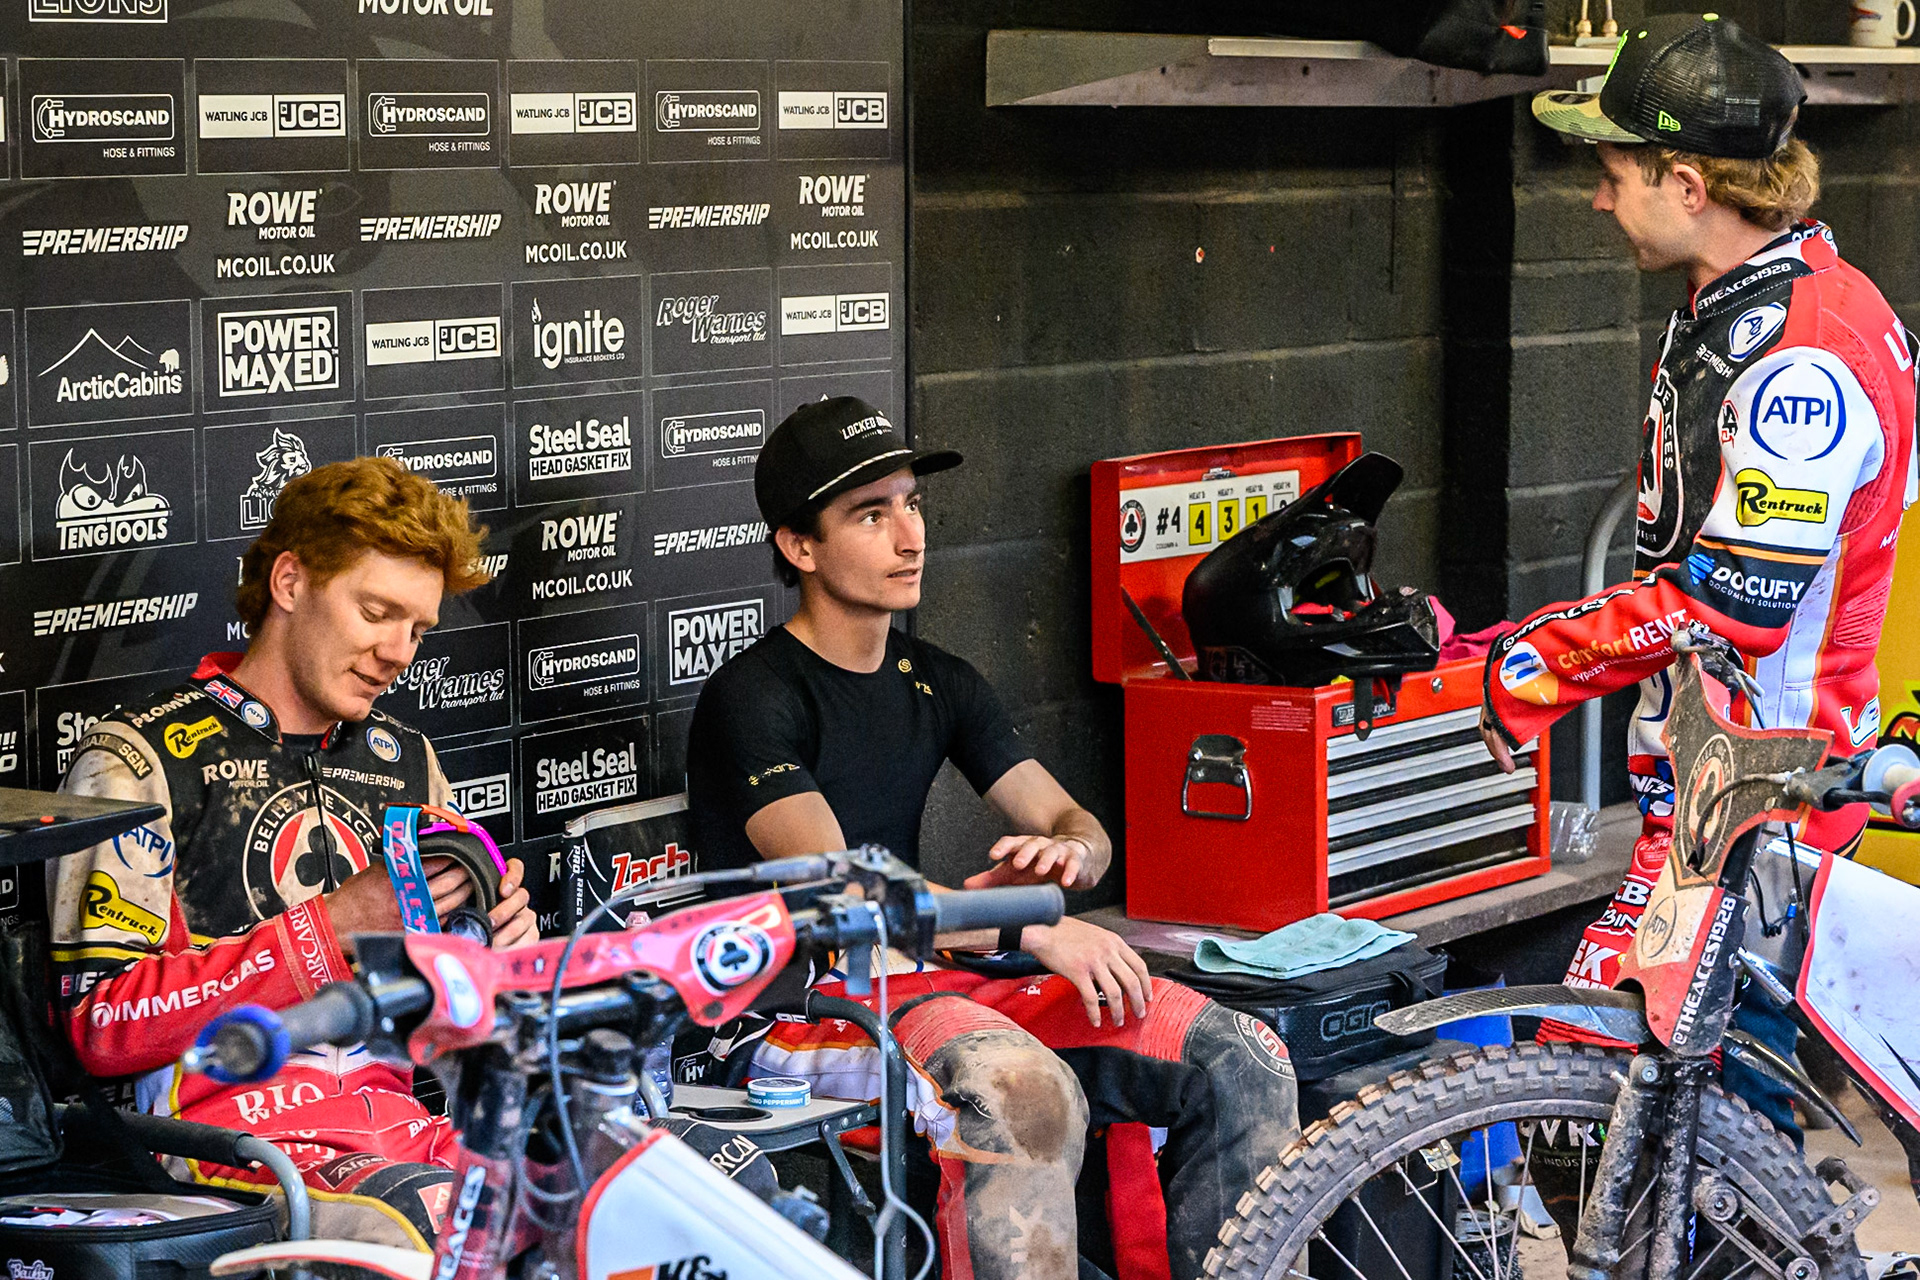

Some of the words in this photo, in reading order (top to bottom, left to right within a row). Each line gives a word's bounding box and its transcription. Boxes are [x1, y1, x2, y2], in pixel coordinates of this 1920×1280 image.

[49, 107, 170, 128] HYDROSCAND
[205, 110, 247, 123] WATLING
[249, 110, 268, 122] JCB
[281, 104, 340, 128] JCB
[382, 107, 486, 123] HYDROSCAND
[516, 108, 552, 118] WATLING
[554, 108, 570, 118] JCB
[580, 101, 632, 124] JCB
[669, 104, 757, 119] HYDROSCAND
[783, 106, 815, 115] WATLING
[816, 106, 829, 115] JCB
[838, 100, 883, 121] JCB
[103, 147, 130, 158] HOSE
[137, 146, 175, 158] FITTINGS
[429, 142, 449, 151] HOSE
[458, 142, 490, 151] FITTINGS
[534, 182, 613, 214] ROWE
[799, 175, 865, 204] ROWE
[227, 190, 318, 226] ROWE
[561, 215, 594, 227] MOTOR
[596, 214, 610, 226] OIL
[655, 204, 770, 229] PREMIERSHIP
[822, 206, 850, 217] MOTOR
[851, 206, 864, 216] OIL
[30, 225, 189, 256] PREMIERSHIP
[259, 226, 297, 239] MOTOR
[299, 225, 315, 238] OIL
[367, 214, 501, 241] PREMIERSHIP
[791, 230, 879, 250] MCOIL.CO.UK
[525, 241, 627, 263] MCOIL.CO.UK
[217, 254, 335, 278] MCOIL.CO.UK
[656, 295, 720, 326] Roger
[786, 311, 818, 320] WATLING
[819, 309, 832, 319] JCB
[840, 301, 886, 324] JCB
[224, 316, 332, 354] POWER
[440, 326, 496, 351] JCB
[532, 309, 625, 369] ignite
[691, 311, 767, 344] Warnes
[711, 333, 751, 345] transport
[753, 331, 767, 342] ltd
[372, 337, 411, 349] WATLING
[413, 336, 429, 347] JCB
[225, 349, 334, 394] MAXED
[564, 354, 592, 364] INSURANCE
[57, 371, 182, 402] ArcticCabins
[1762, 396, 1831, 427] ATPI
[529, 420, 585, 455] Steel
[585, 416, 631, 450] Seal
[674, 423, 761, 445] HYDROSCAND
[842, 416, 876, 440] LOCKED
[531, 458, 563, 478] HEAD
[564, 454, 610, 473] GASKET
[611, 451, 629, 469] FIX
[713, 456, 730, 467] HOSE
[464, 483, 497, 494] FITTINGS
[1737, 482, 1822, 515] Rentruck
[541, 513, 618, 551] ROWE
[1156, 506, 1180, 535] #4
[1195, 510, 1204, 536] 4
[1223, 506, 1233, 533] 3
[568, 549, 600, 562] MOTOR
[602, 545, 616, 557] OIL
[532, 569, 633, 600] MCOIL.CO.UK
[1708, 579, 1755, 605] DOCUMENT
[1711, 566, 1805, 600] DOCUFY
[41, 593, 198, 635] PREMIERSHIP
[674, 608, 759, 648] POWER
[542, 649, 636, 676] HYDROSCAND
[419, 669, 505, 710] Warnes
[441, 693, 487, 708] transport
[489, 690, 505, 702] ltd
[584, 686, 603, 697] HOSE
[611, 679, 640, 694] FITTINGS
[168, 721, 219, 753] Rentruck
[373, 736, 393, 752] ATPI
[118, 743, 151, 777] SGN
[201, 759, 270, 785] ROWE
[536, 752, 589, 789] Steel
[592, 742, 637, 779] Seal
[324, 767, 405, 791] PREMIERSHIP
[538, 788, 570, 811] HEAD
[571, 780, 616, 804] GASKET
[617, 775, 636, 795] FIX
[253, 797, 293, 853] BELLE
[342, 810, 375, 853] ACE
[123, 825, 172, 862] ATPI
[86, 884, 158, 937] Rentruck
[1671, 895, 1737, 1046] @THEACES1928
[114, 948, 275, 1022] IMMERGAS
